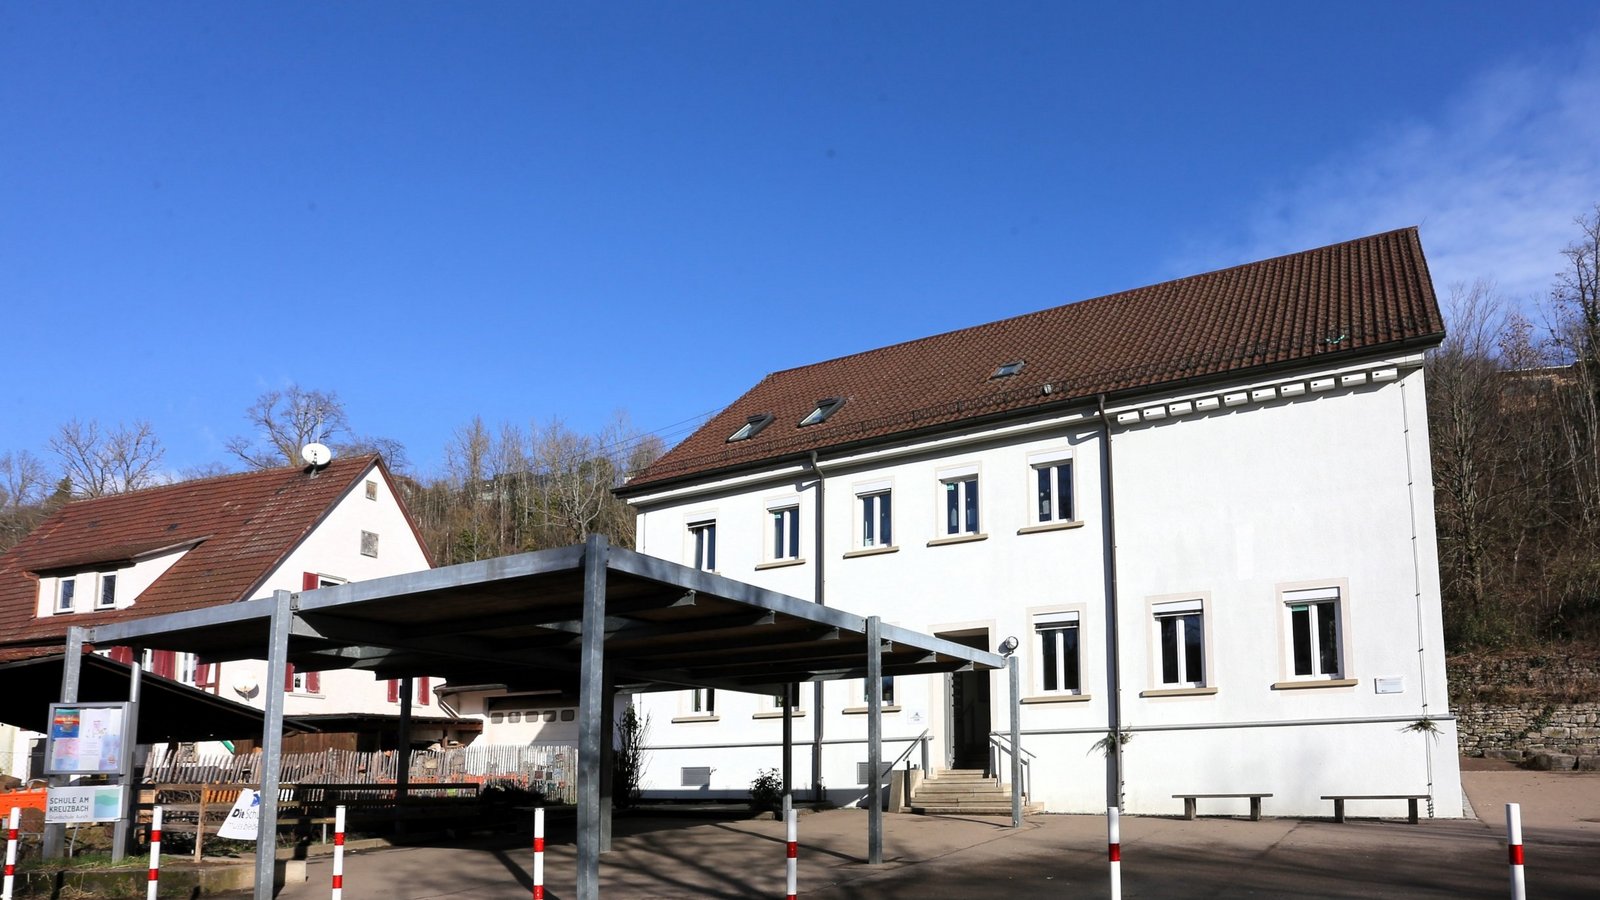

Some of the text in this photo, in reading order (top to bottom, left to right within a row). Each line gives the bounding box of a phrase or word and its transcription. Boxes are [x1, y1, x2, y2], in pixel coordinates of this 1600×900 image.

[49, 797, 76, 805] SCHULE
[49, 805, 88, 813] KREUZBACH
[231, 808, 245, 818] Die
